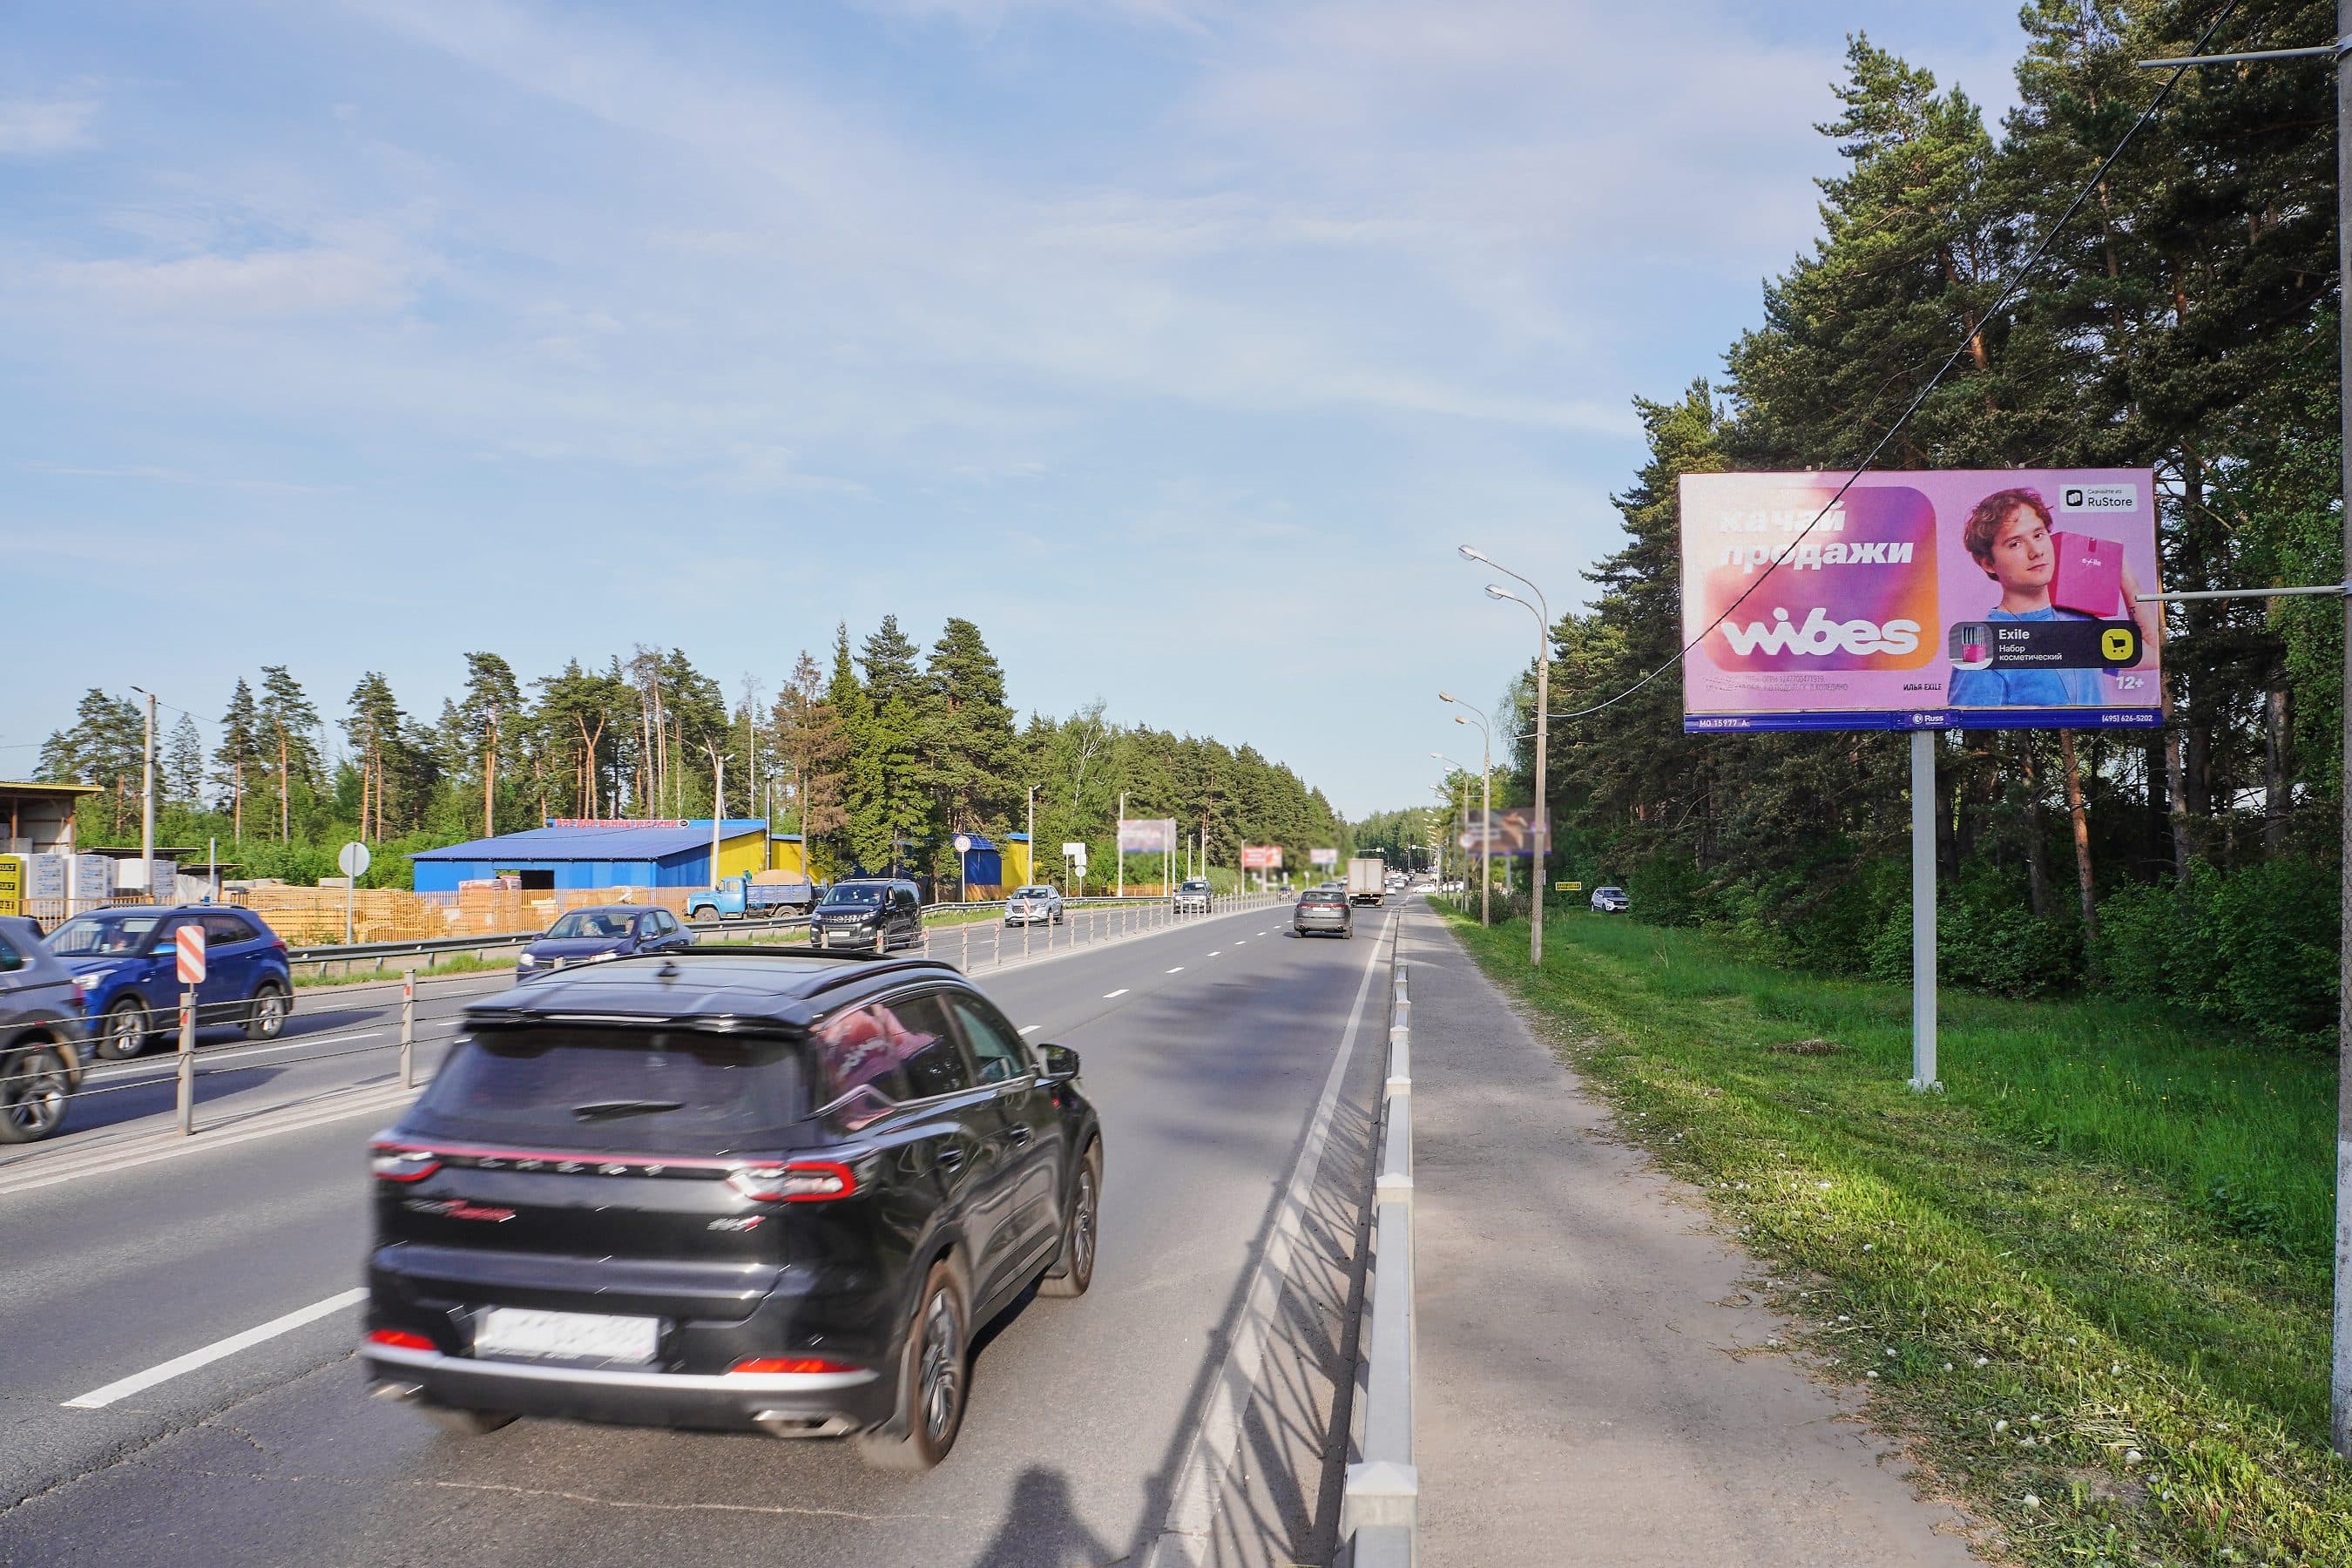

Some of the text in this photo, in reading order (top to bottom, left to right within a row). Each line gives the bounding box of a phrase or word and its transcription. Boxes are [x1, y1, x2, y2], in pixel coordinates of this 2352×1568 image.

[2088, 497, 2132, 506] RuStore
[1720, 500, 1846, 531] качай
[1721, 542, 1915, 574] продажи
[1721, 607, 1922, 655] wibes
[1998, 629, 2030, 640] Exile
[1998, 645, 2025, 653] Набор
[1999, 652, 2063, 662] косметический
[2116, 676, 2144, 690] 12+
[2101, 714, 2119, 723] (495)
